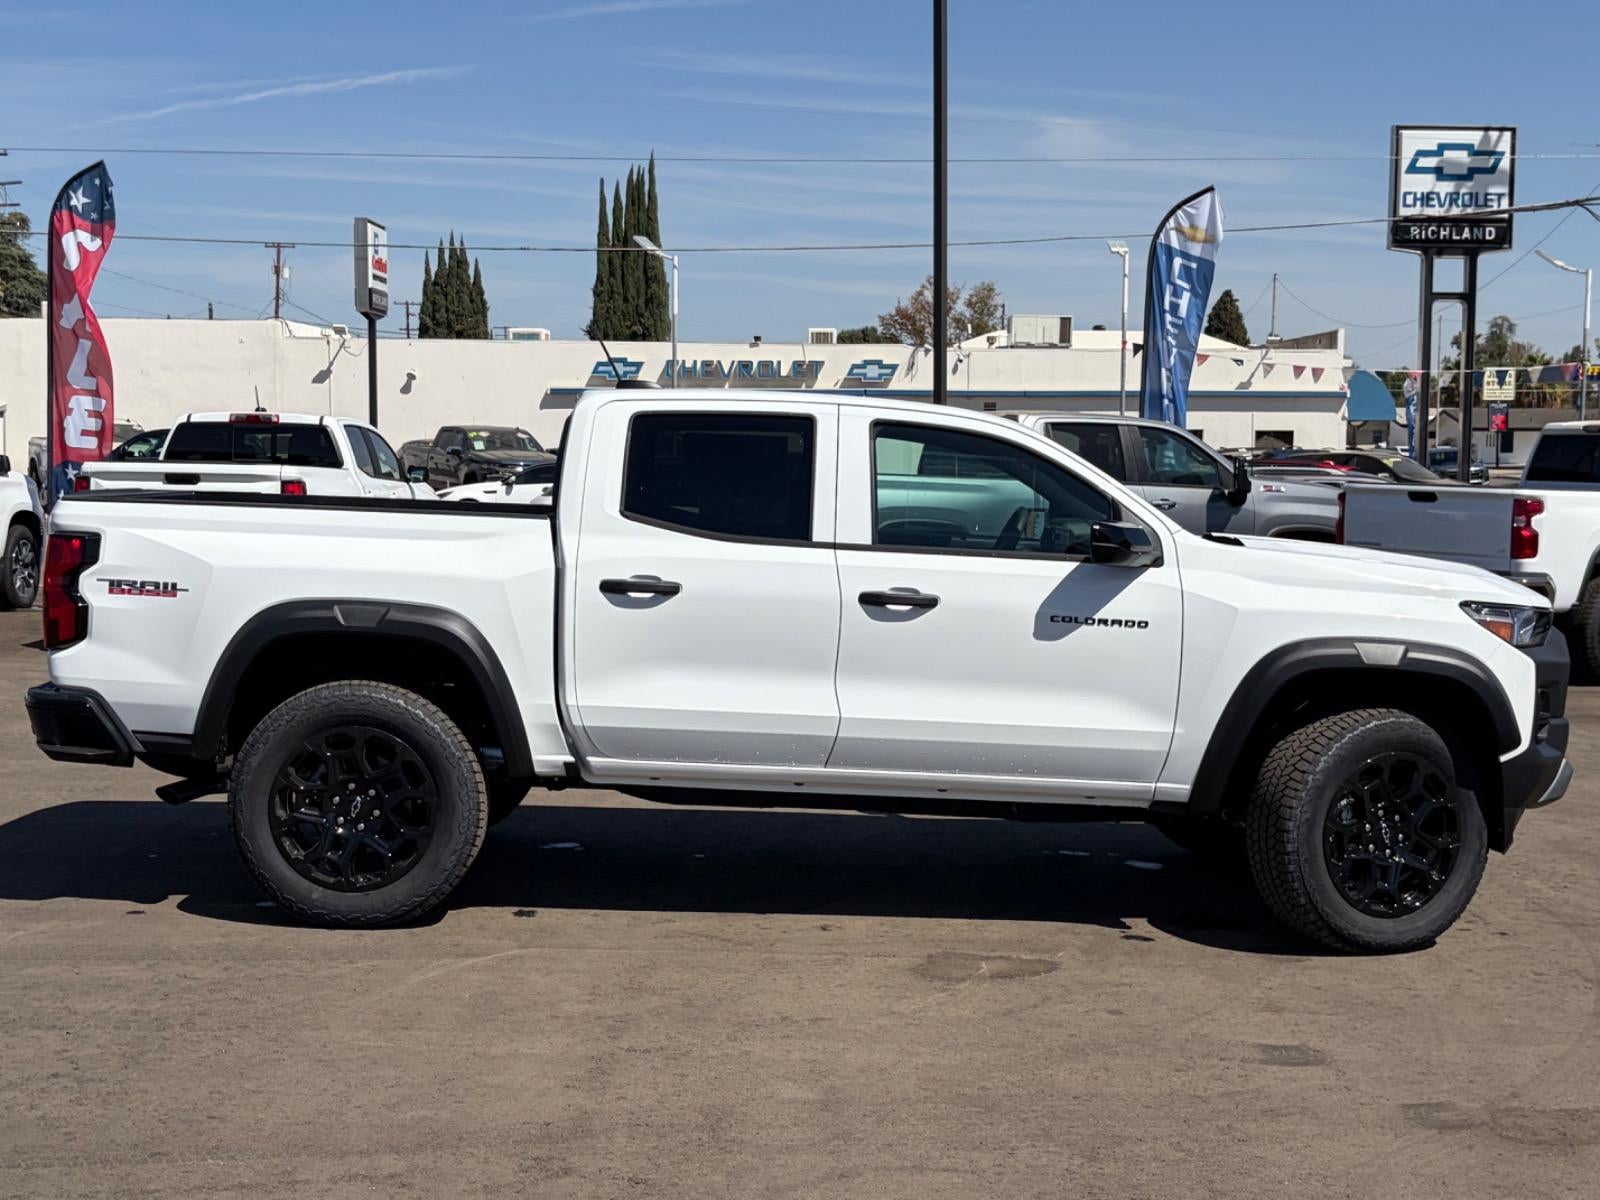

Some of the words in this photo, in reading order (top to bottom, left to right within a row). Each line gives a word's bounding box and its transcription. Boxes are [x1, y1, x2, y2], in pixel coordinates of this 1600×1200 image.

[1402, 191, 1505, 208] CHEVROLET
[1411, 226, 1496, 240] RICHLAND
[664, 360, 825, 380] CHEVROLET
[1050, 615, 1149, 629] COLORADO
